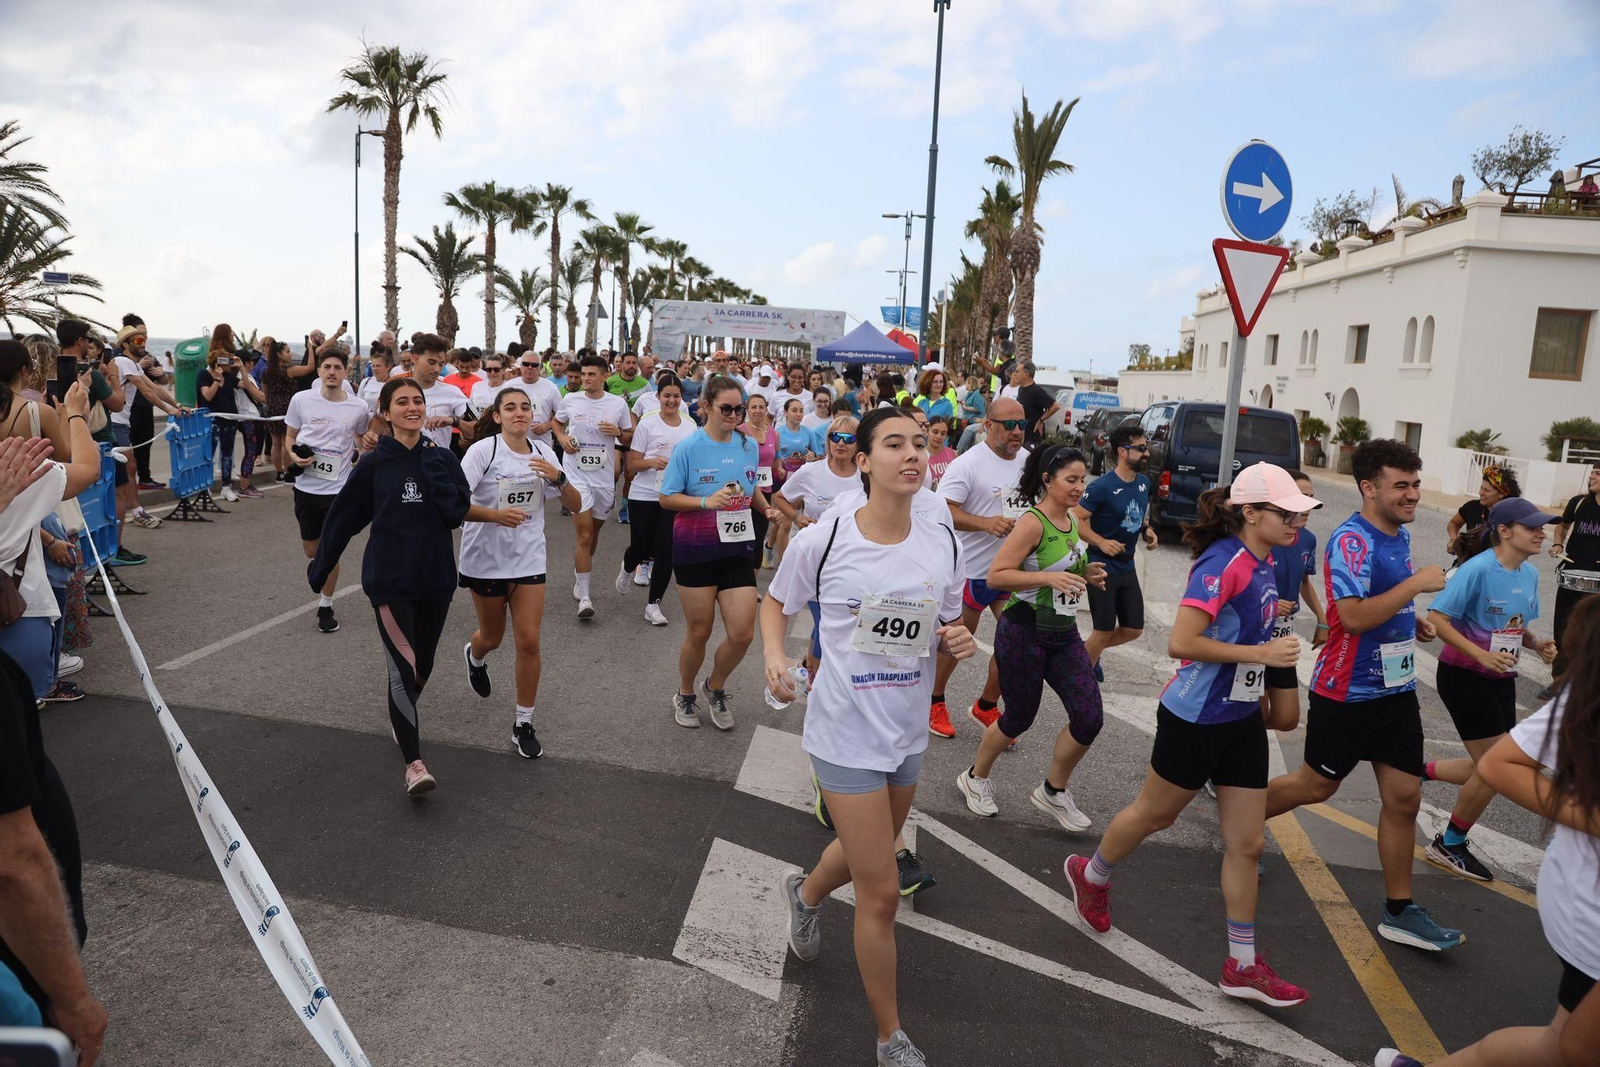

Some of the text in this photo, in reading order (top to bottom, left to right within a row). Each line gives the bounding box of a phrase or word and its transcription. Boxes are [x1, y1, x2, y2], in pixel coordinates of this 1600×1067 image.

[727, 310, 769, 319] CARRERA
[835, 351, 896, 360] info@dorsalchip.es
[312, 460, 333, 473] 143
[580, 455, 601, 465] 633
[931, 462, 948, 475] YOU
[507, 491, 534, 504] 657
[724, 521, 746, 533] 766
[872, 617, 920, 640] 490
[1334, 639, 1350, 671] TRIATLON
[877, 672, 914, 682] TRASPLANTE
[1178, 668, 1199, 699] TRIATLON
[279, 940, 290, 959] Málaga
[291, 961, 312, 996] Ayuntamiento
[332, 1028, 346, 1053] Málaga
